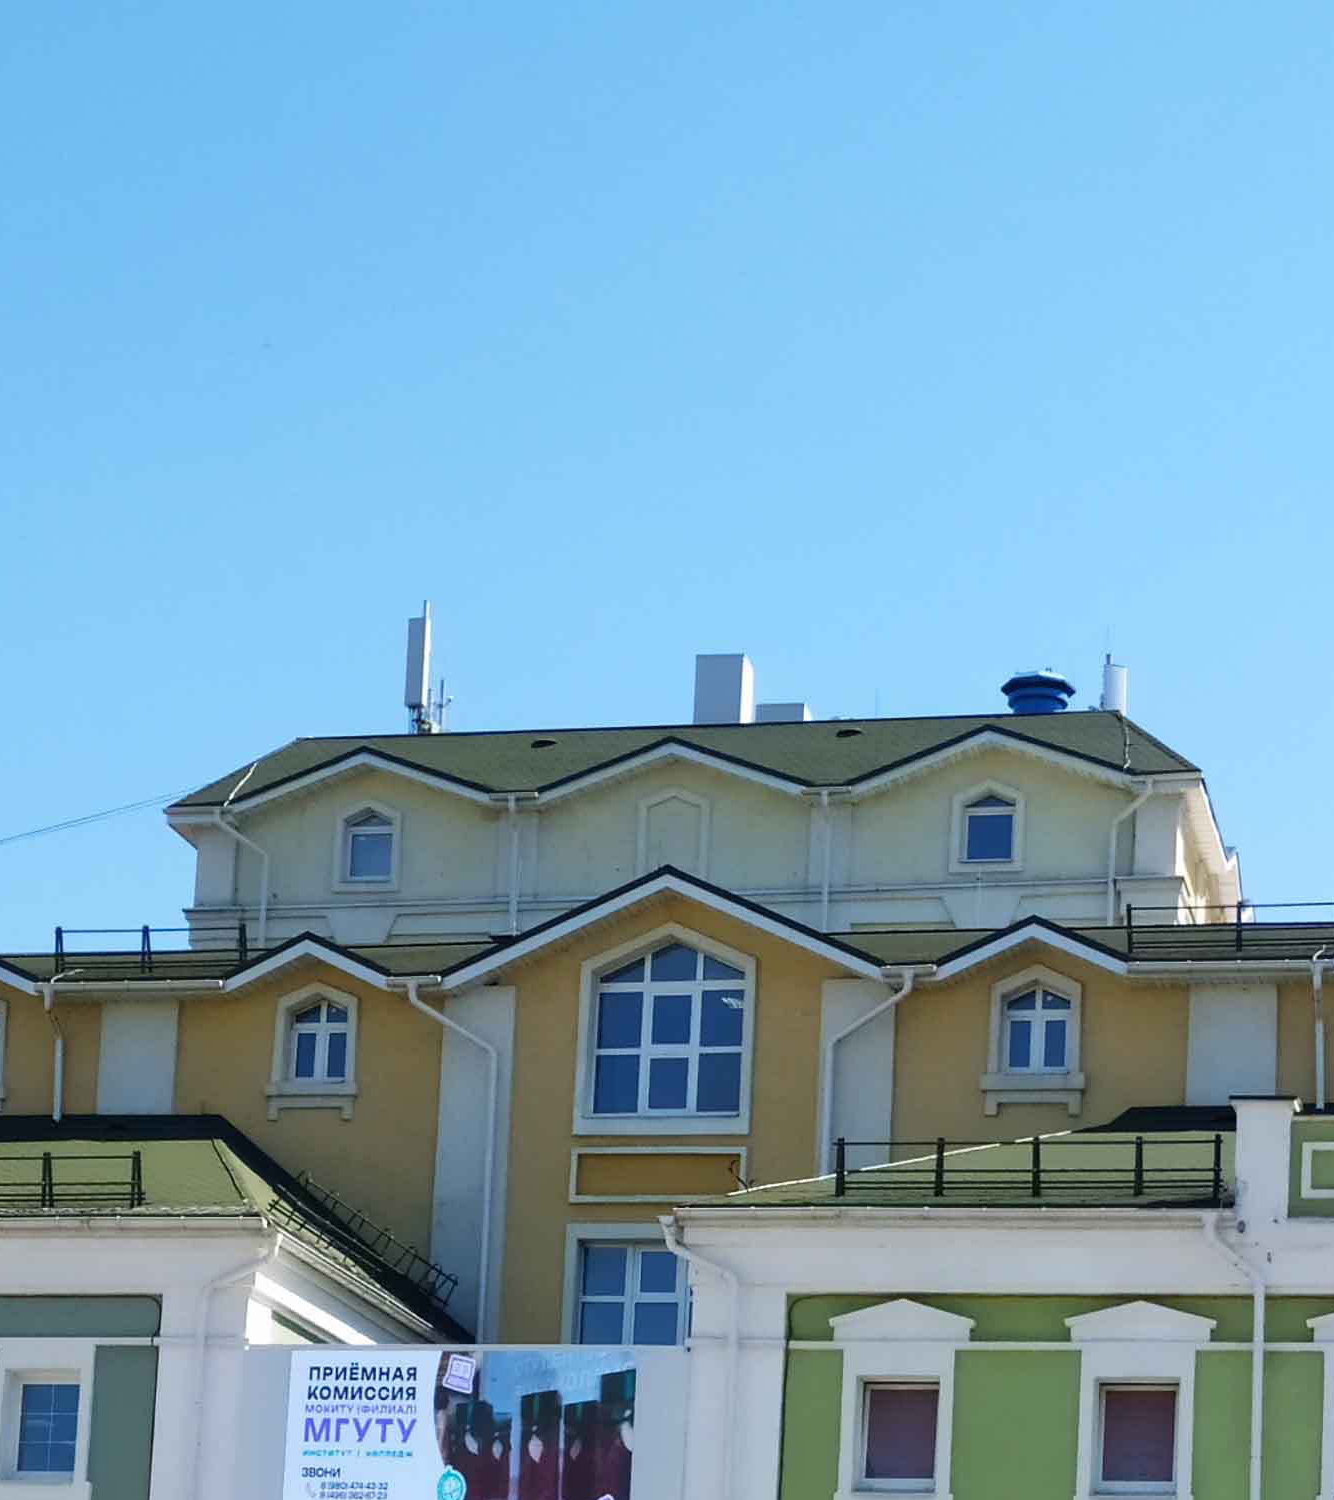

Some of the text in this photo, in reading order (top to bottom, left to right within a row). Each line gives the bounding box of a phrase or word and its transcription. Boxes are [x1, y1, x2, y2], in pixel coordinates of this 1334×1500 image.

[309, 1362, 417, 1381] ПРИЁМНАЯ
[307, 1385, 417, 1401] КОМИССИЯ
[303, 1417, 417, 1443] МГУТУ
[301, 1467, 341, 1478] ЗВОНИ
